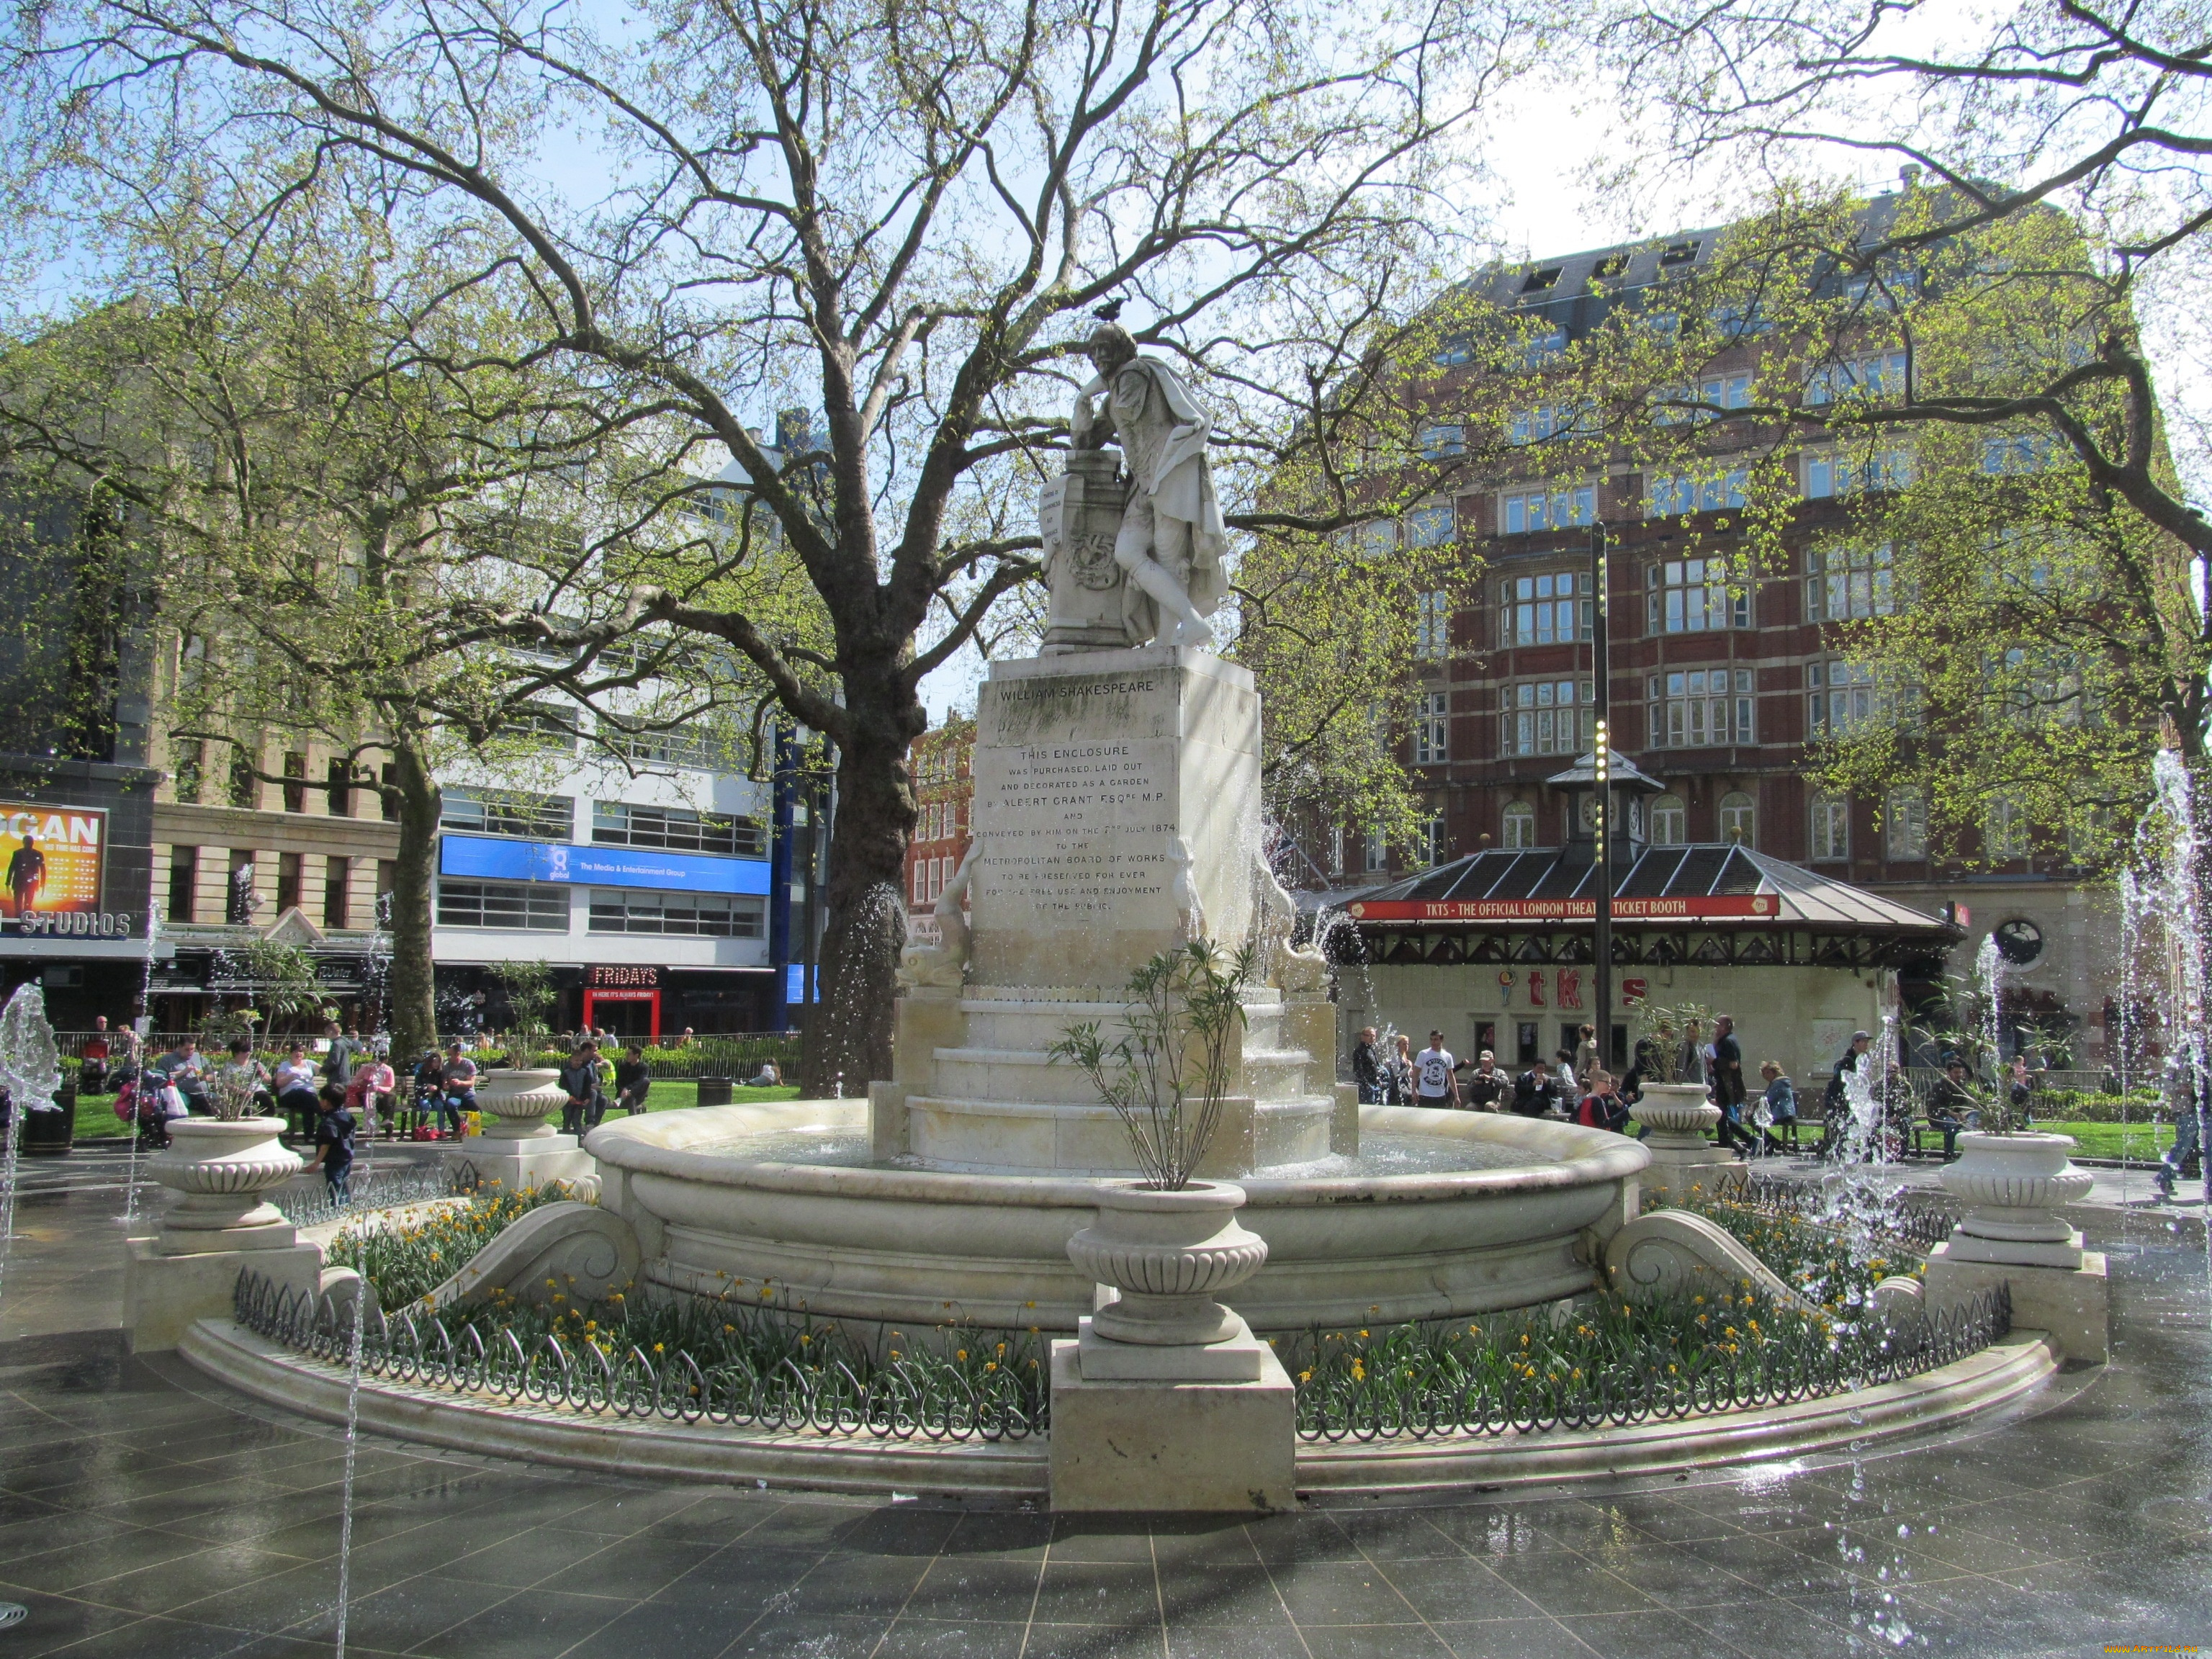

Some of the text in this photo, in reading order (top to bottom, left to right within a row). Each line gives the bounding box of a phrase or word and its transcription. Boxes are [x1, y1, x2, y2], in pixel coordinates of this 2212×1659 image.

[1001, 681, 1154, 701] WILLIAM SHAKESPEARE
[1020, 747, 1129, 760] THIS ENCLOSURE
[1095, 764, 1117, 773] LAID
[1123, 763, 1143, 771] OUT
[1024, 781, 1078, 790] DECORATED
[1110, 778, 1149, 786] GARDEN
[1003, 797, 1048, 806] ALBERT
[1053, 796, 1093, 805] GRANT
[1142, 792, 1166, 801] M.P.
[0, 811, 99, 845] GAN
[1151, 824, 1178, 832] 1874.
[984, 856, 1060, 866] METROPOLITAN
[1066, 855, 1102, 864] BOARD
[1128, 854, 1166, 863] WORKS
[549, 871, 570, 881] global
[580, 862, 593, 871] The
[594, 863, 615, 872] Media
[622, 866, 665, 876] Entertainment
[666, 868, 685, 878] Group
[1426, 904, 1449, 917] TKTS
[1457, 903, 1476, 916] THE
[1479, 902, 1521, 916] OFFICIAL
[1523, 902, 1564, 915] LONDON
[1566, 902, 1596, 915] THEAT
[1613, 902, 1647, 914] TICKET
[1650, 901, 1686, 914] BOOTH
[20, 909, 131, 936] STUDIOS
[318, 966, 351, 979] Water
